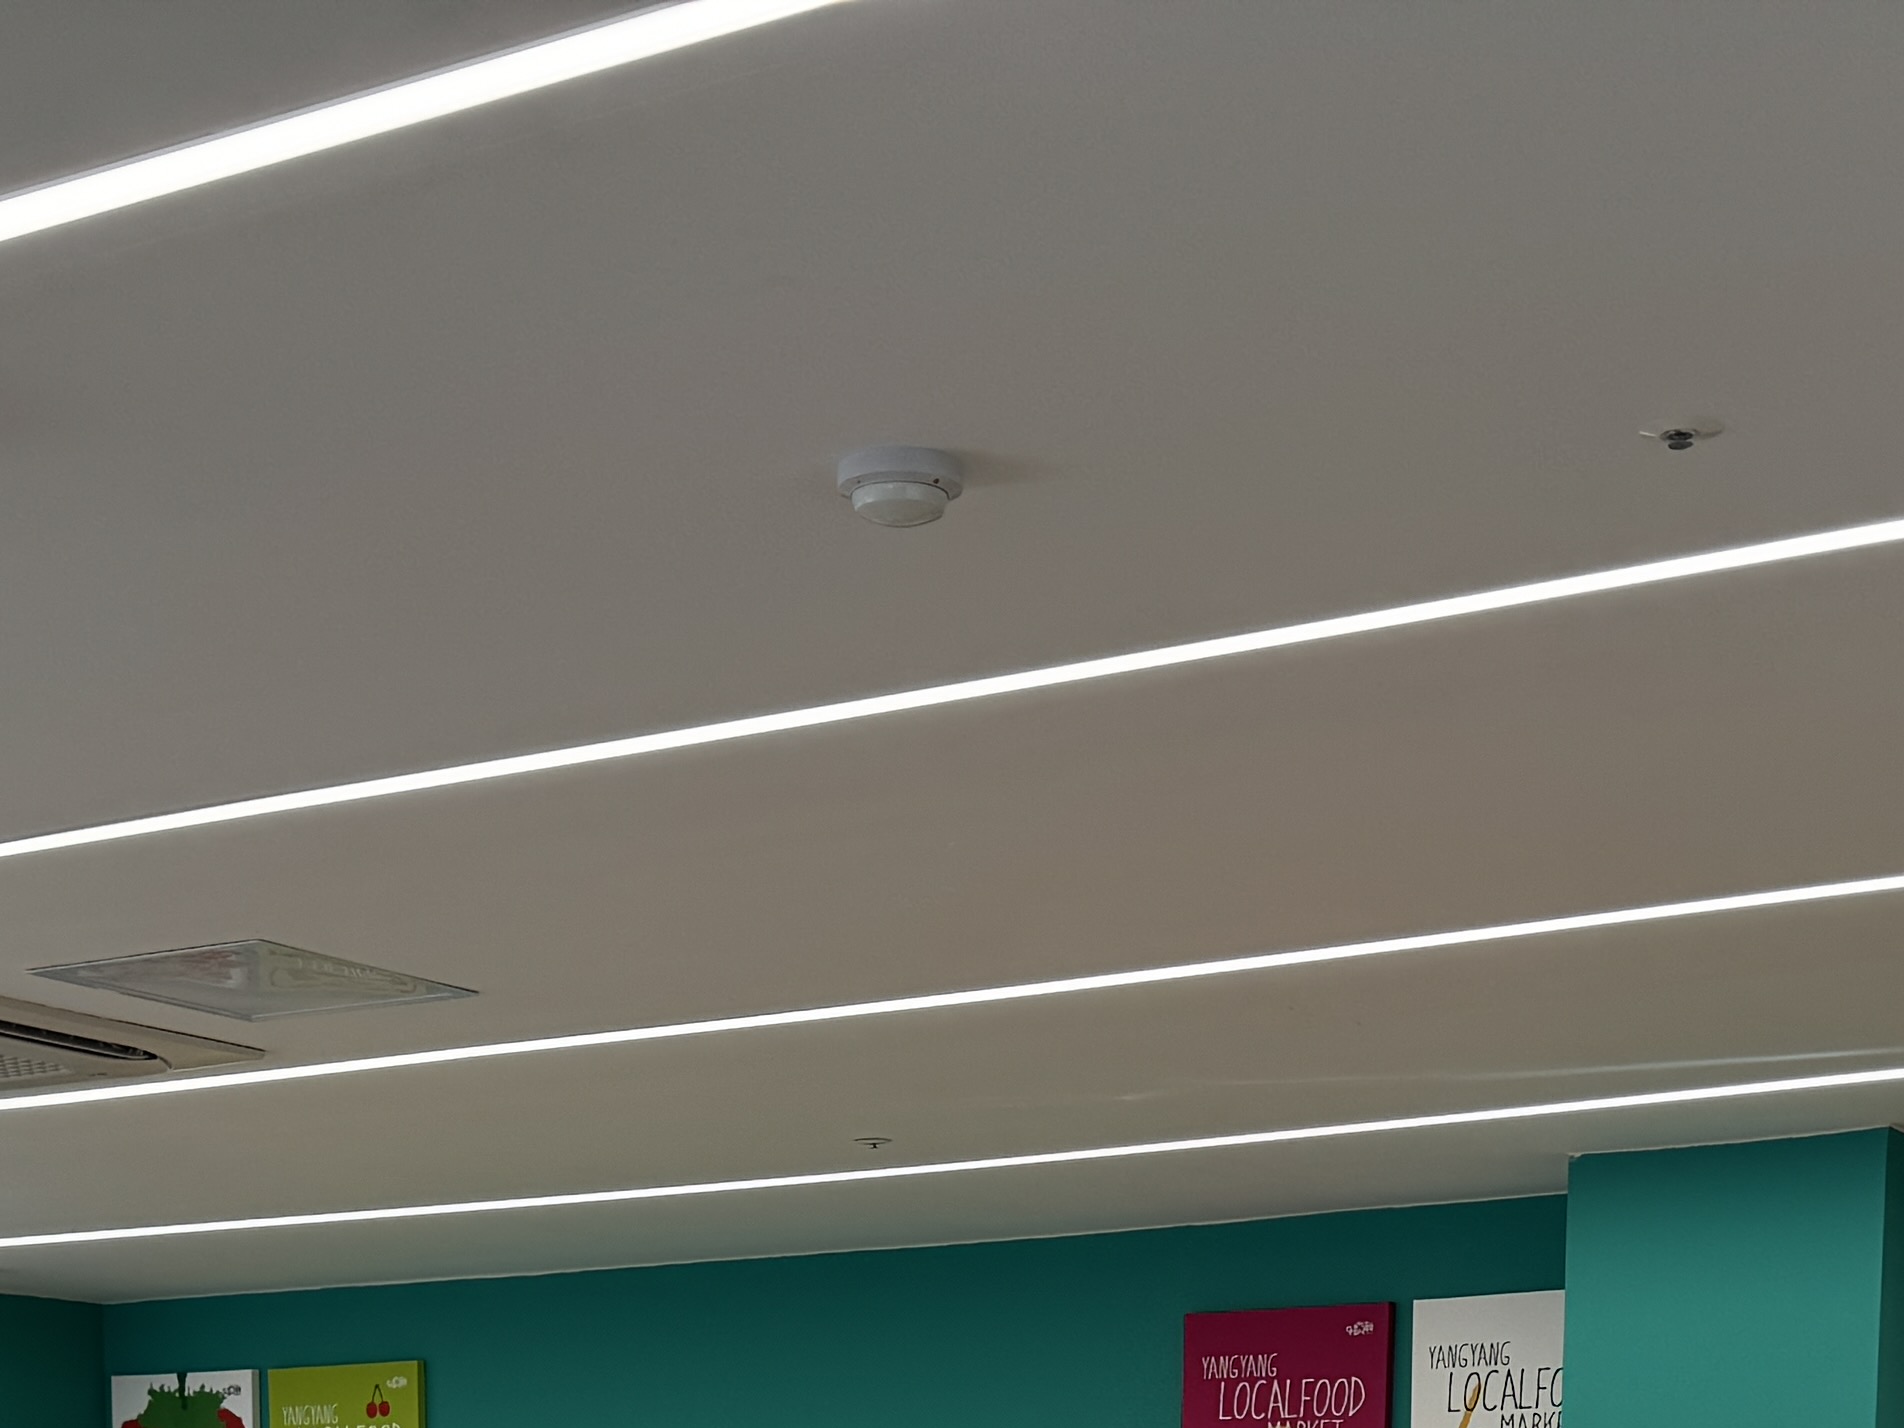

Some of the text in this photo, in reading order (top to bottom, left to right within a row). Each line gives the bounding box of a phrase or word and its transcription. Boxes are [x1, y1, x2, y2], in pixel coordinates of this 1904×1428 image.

[1202, 1353, 1278, 1379] YANGYANG
[1428, 1341, 1511, 1369] YANGYANG
[1219, 1377, 1365, 1421] LOCALFOOD
[282, 1404, 338, 1426] YANGYANG
